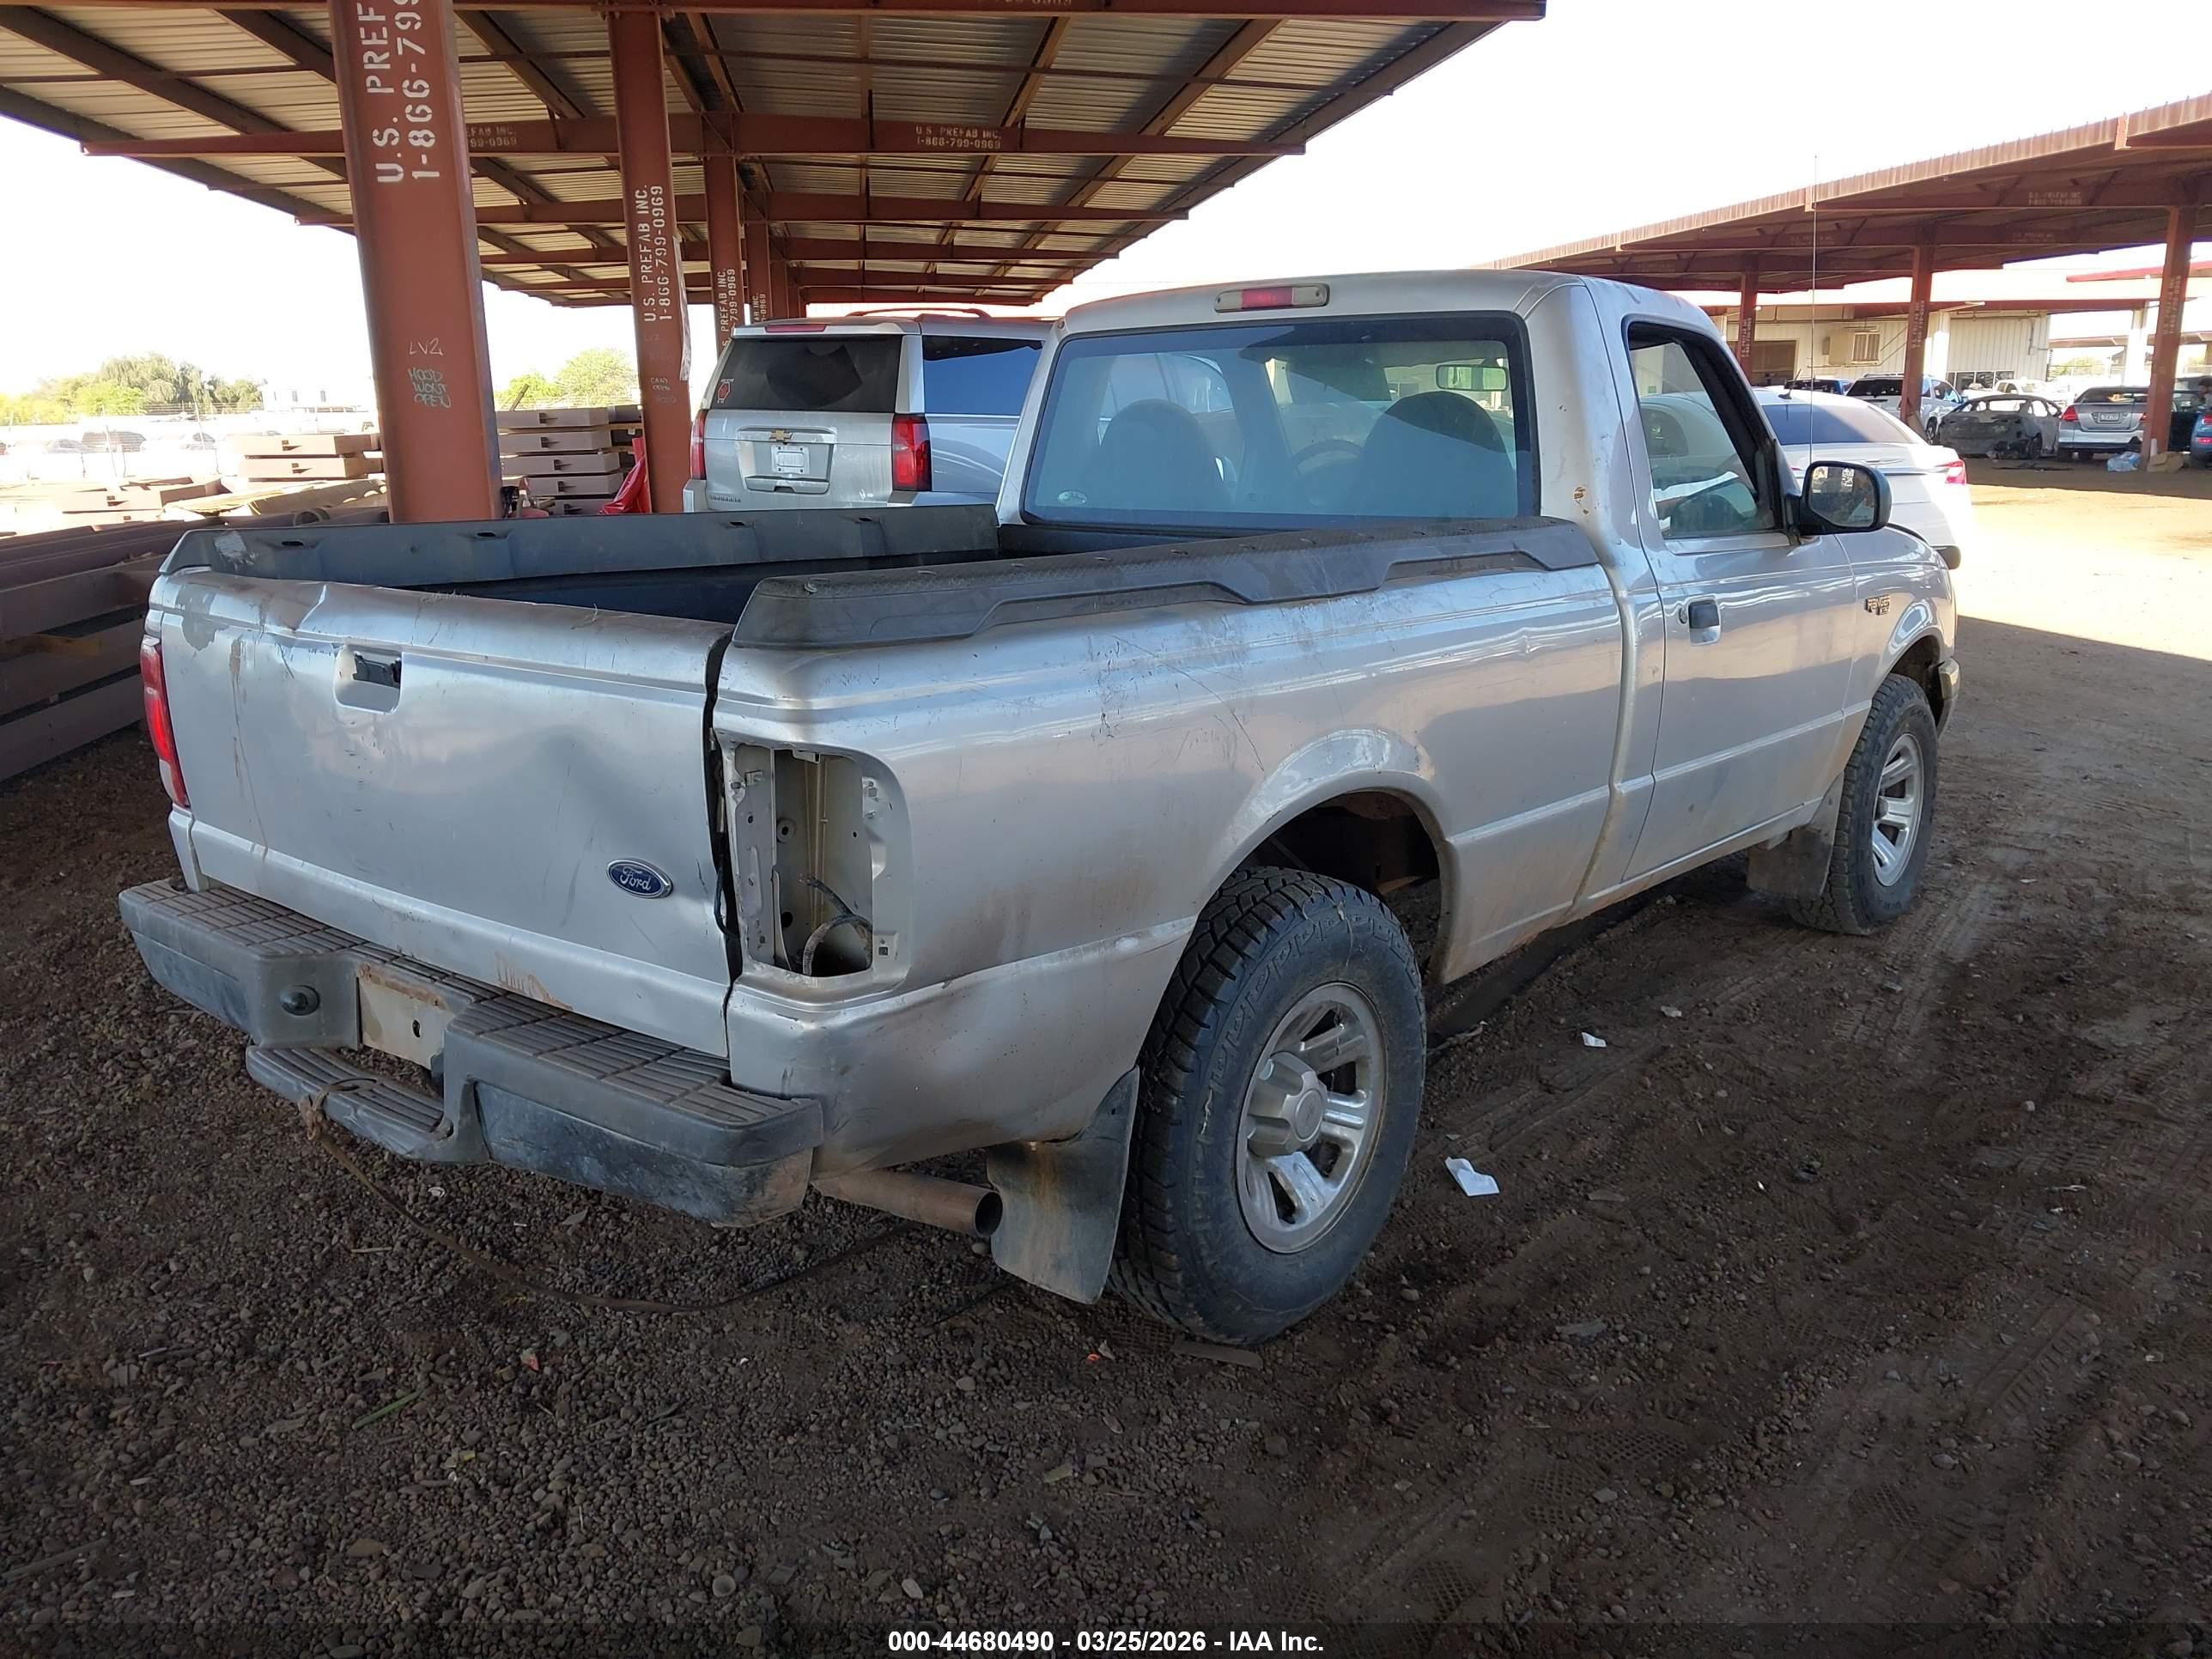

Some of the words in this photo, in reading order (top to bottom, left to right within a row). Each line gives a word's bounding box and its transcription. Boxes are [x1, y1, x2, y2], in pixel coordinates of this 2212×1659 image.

[393, 0, 441, 179] 1-866-79
[917, 137, 1001, 149] 1-866-799-0969
[939, 126, 978, 138] PREFAB
[372, 117, 404, 183] U.S.
[635, 185, 649, 214] INC.
[638, 222, 654, 283] PREFAB
[650, 185, 672, 320] 1-866-799-0969
[717, 268, 727, 288] INC.
[643, 293, 657, 322] U.S.
[718, 293, 729, 331] PREFAB
[619, 866, 652, 891] Ford
